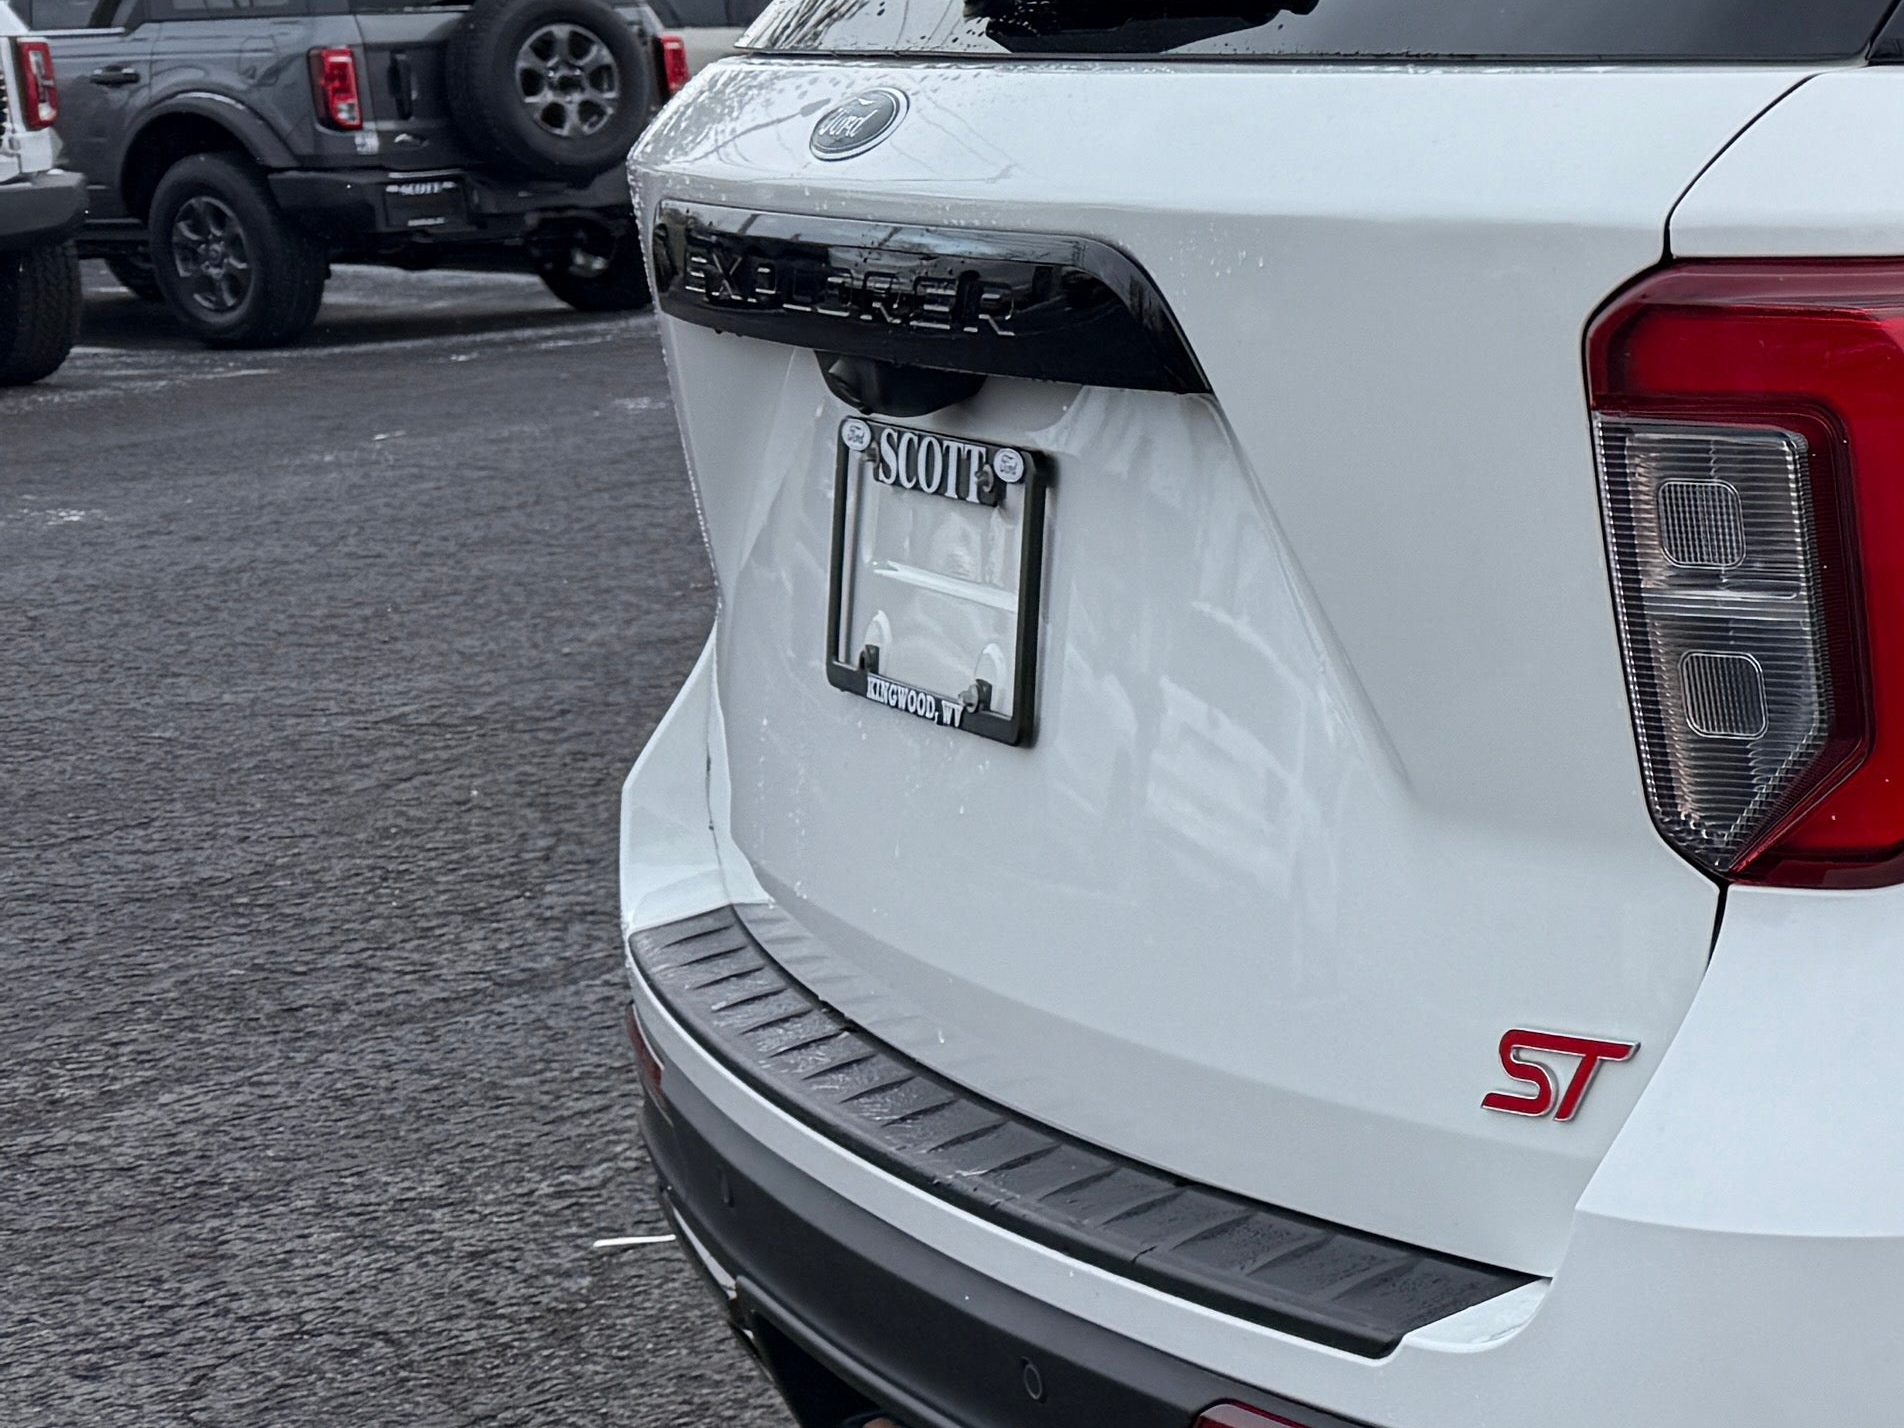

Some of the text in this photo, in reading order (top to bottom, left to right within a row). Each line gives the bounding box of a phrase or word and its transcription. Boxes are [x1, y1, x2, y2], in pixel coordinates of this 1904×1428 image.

[817, 104, 880, 138] Ford
[684, 253, 1017, 338] EXPLORER
[877, 427, 987, 504] SCOTT
[865, 675, 965, 728] KINGWOOD, WV
[1480, 1027, 1642, 1123] ST
